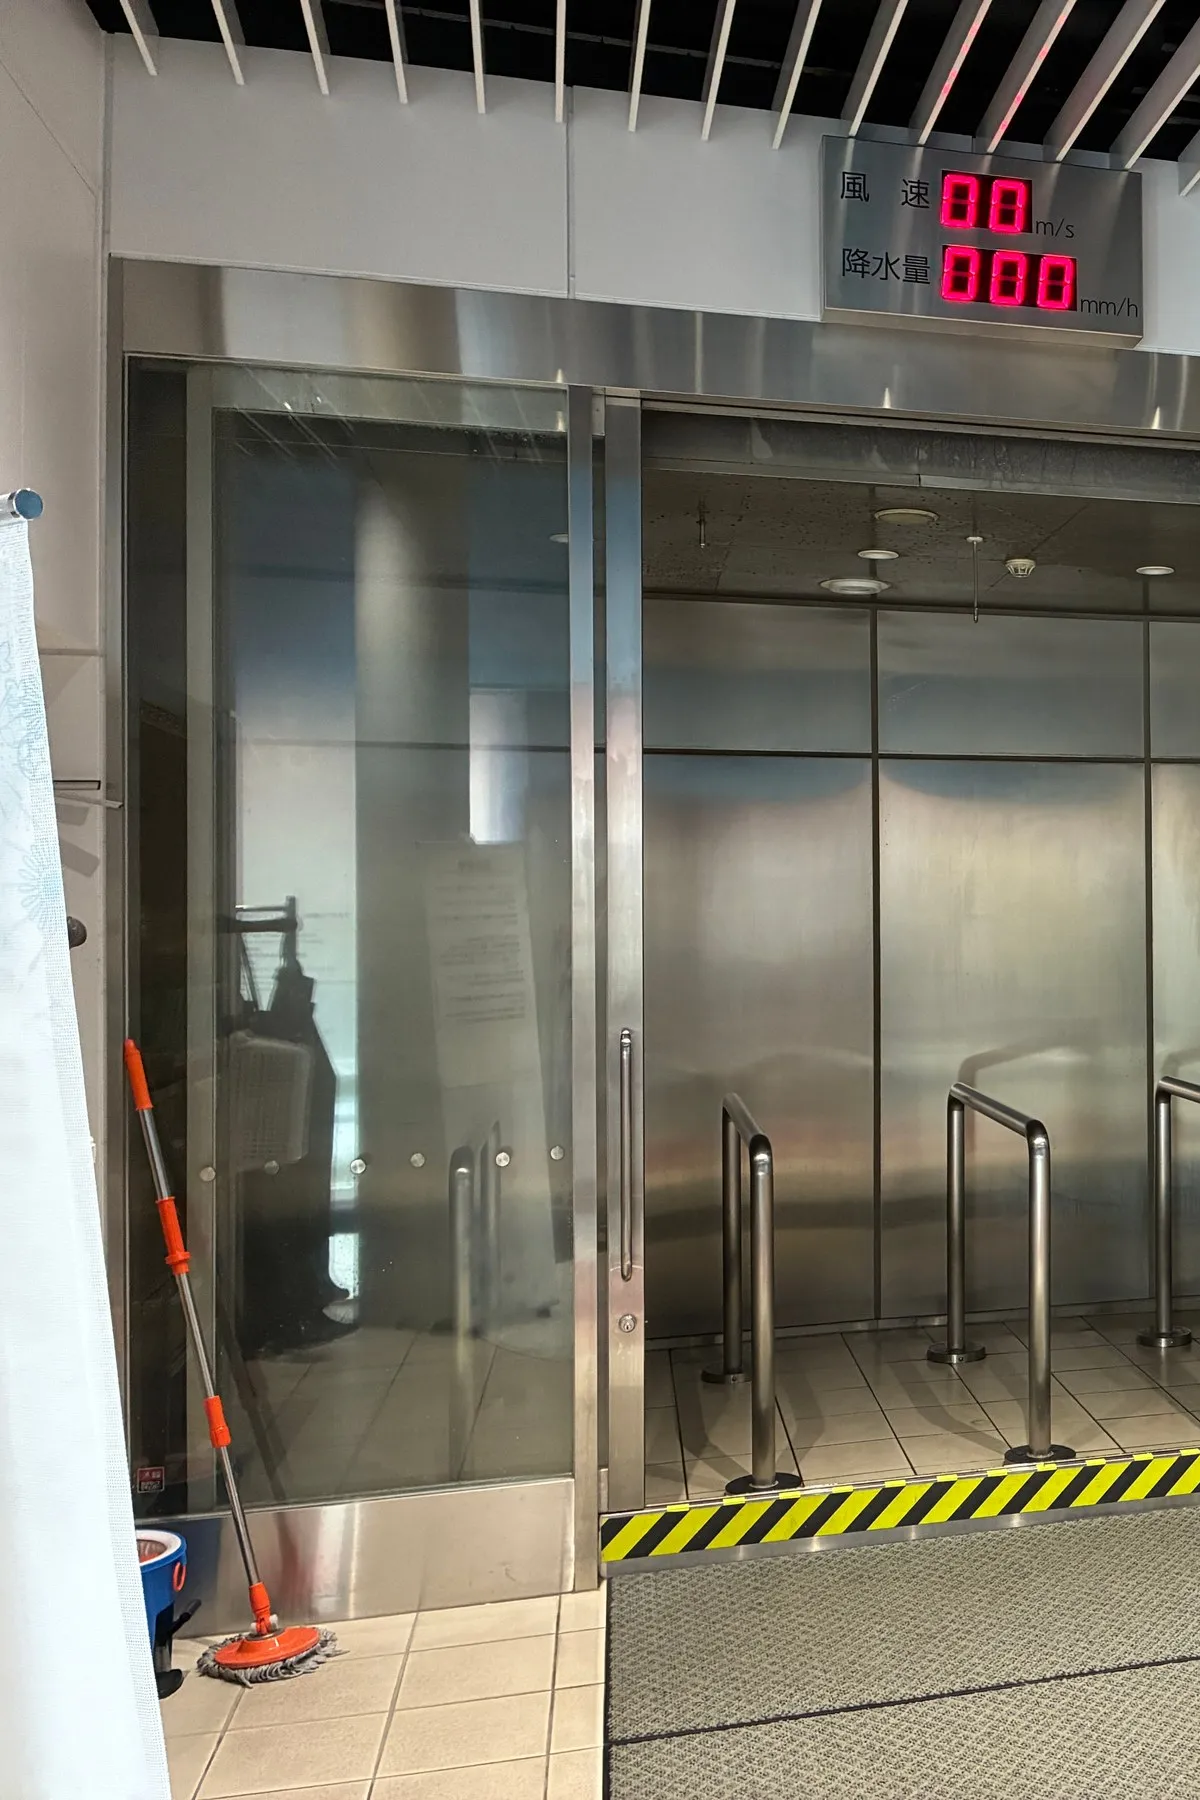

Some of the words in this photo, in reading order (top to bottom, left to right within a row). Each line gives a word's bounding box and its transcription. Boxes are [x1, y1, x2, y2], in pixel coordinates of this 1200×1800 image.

[840, 171, 931, 209] 風速
[940, 173, 1027, 234] 00
[1035, 218, 1076, 239] m/s
[841, 248, 932, 286] 降水量
[940, 245, 1075, 310] 000
[1079, 297, 1139, 318] mm/h
